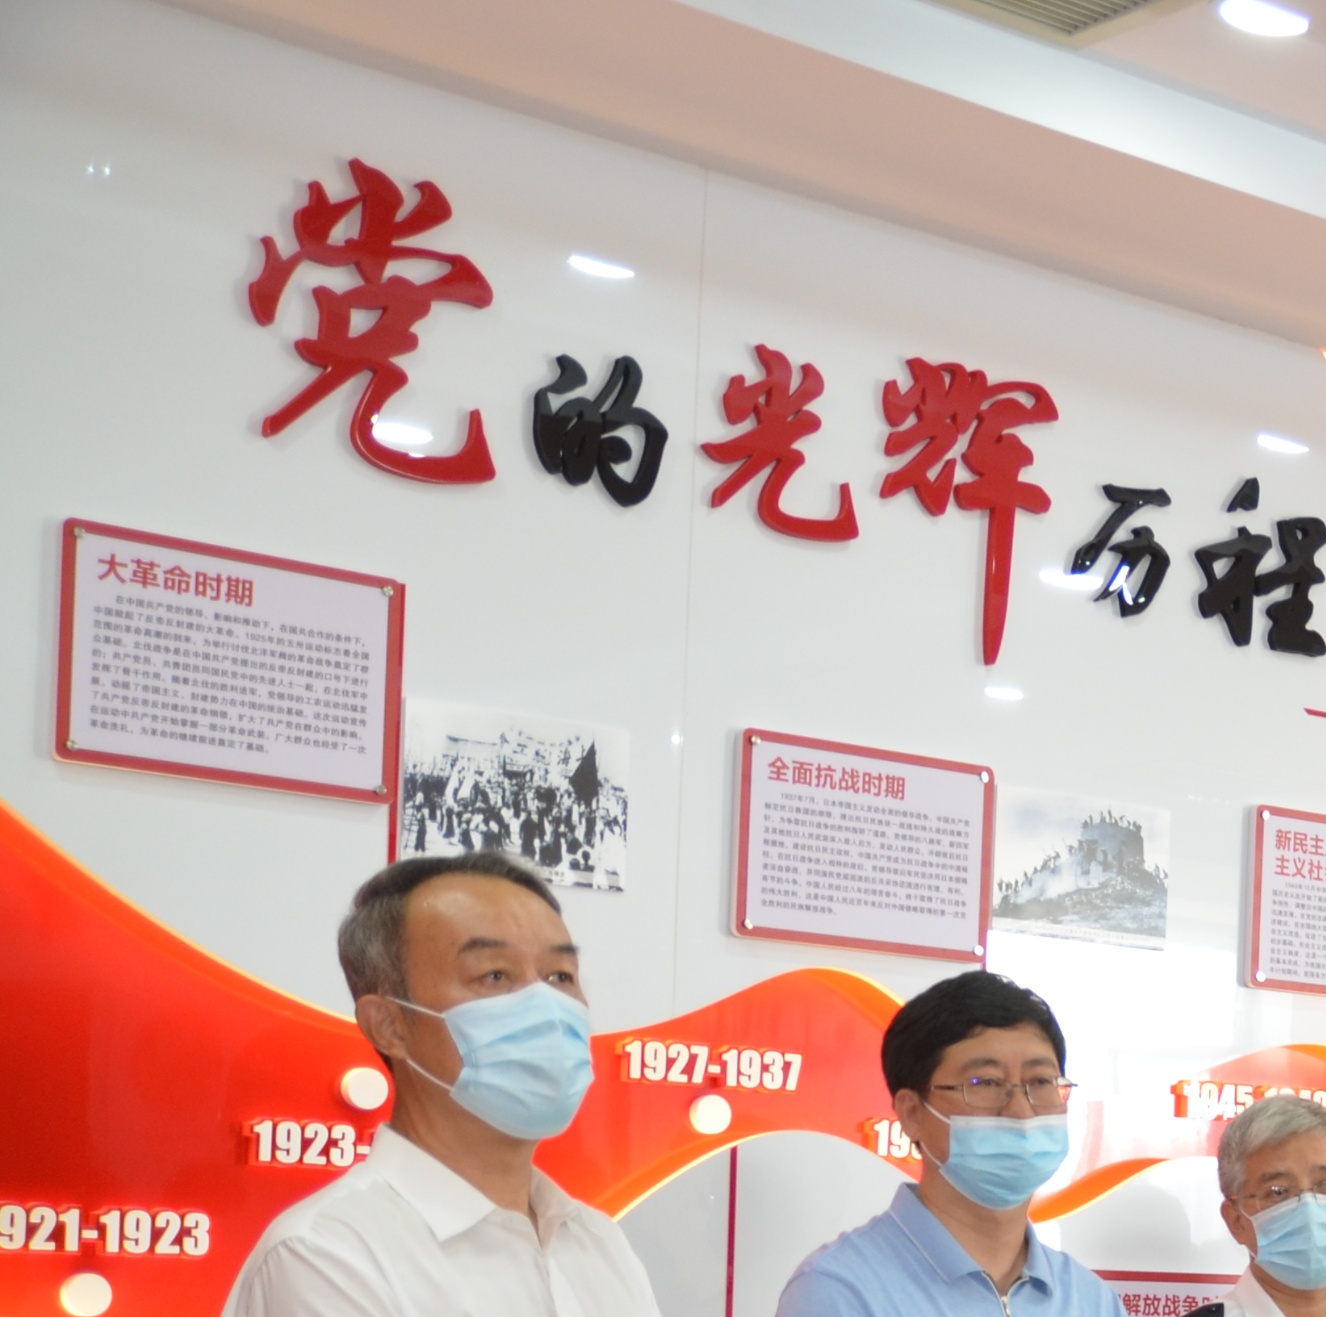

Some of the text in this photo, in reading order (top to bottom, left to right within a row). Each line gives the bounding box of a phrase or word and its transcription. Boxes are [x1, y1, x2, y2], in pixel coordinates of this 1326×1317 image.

[97, 553, 254, 607] 大革命时期
[767, 756, 906, 800] 全面抗战时期
[623, 1039, 803, 1091] 1927-1937
[873, 1119, 923, 1160] 19
